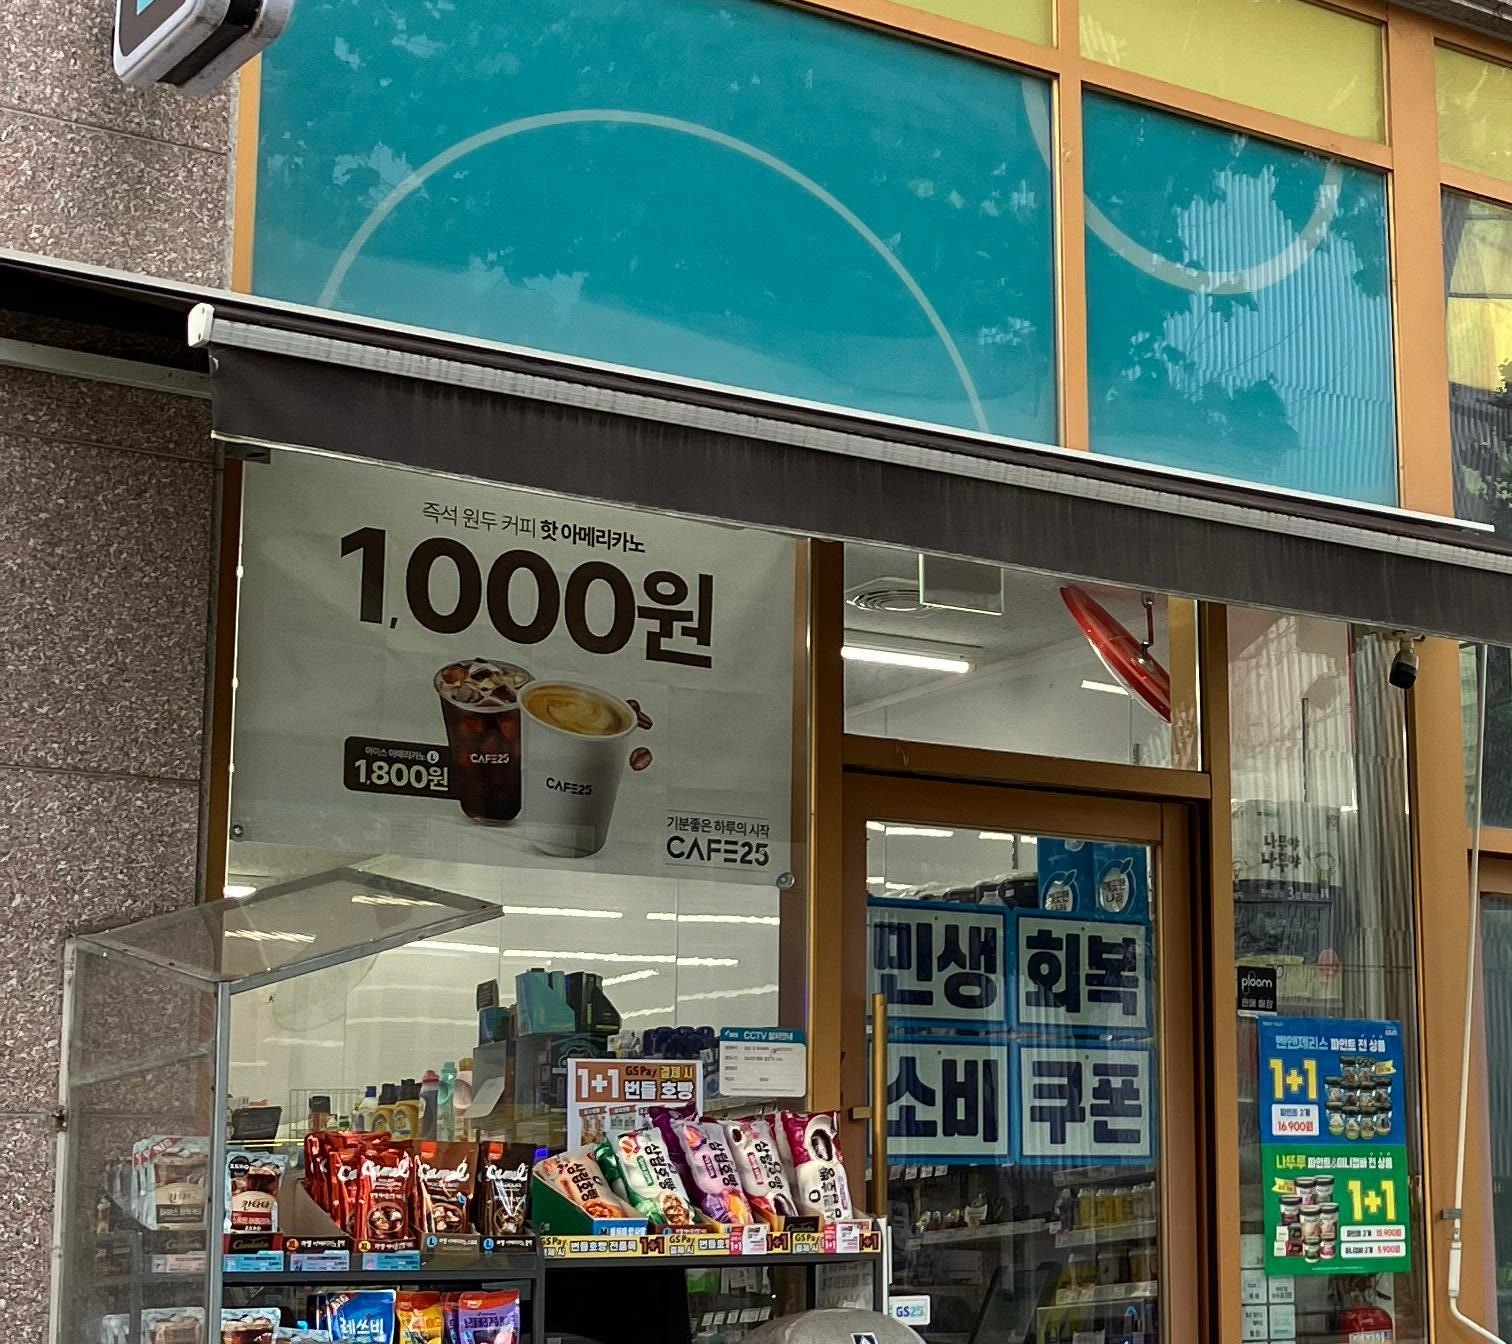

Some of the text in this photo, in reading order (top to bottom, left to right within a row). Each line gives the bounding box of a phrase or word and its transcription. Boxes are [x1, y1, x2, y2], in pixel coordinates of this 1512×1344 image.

[421, 501, 647, 554] 즉석 원두 커피 핫 아메리카노
[340, 524, 714, 669] 1,000원
[470, 752, 510, 765] CAFE25
[354, 758, 449, 792] 1,800원
[545, 777, 593, 796] CAFE25
[713, 819, 748, 837] 하루의
[748, 822, 770, 838] 시작
[666, 835, 770, 867] CAFE25
[872, 921, 1140, 1016] 민생 회복
[1241, 971, 1273, 996] ploom
[578, 1068, 619, 1099] 1+1
[1269, 1058, 1317, 1100] 1+1
[887, 1055, 999, 1144] 소비
[1029, 1059, 1144, 1145] 쿠폰
[1347, 1179, 1396, 1222] 1+1
[339, 1316, 385, 1336] 레쓰비
[896, 1305, 924, 1318] GS25
